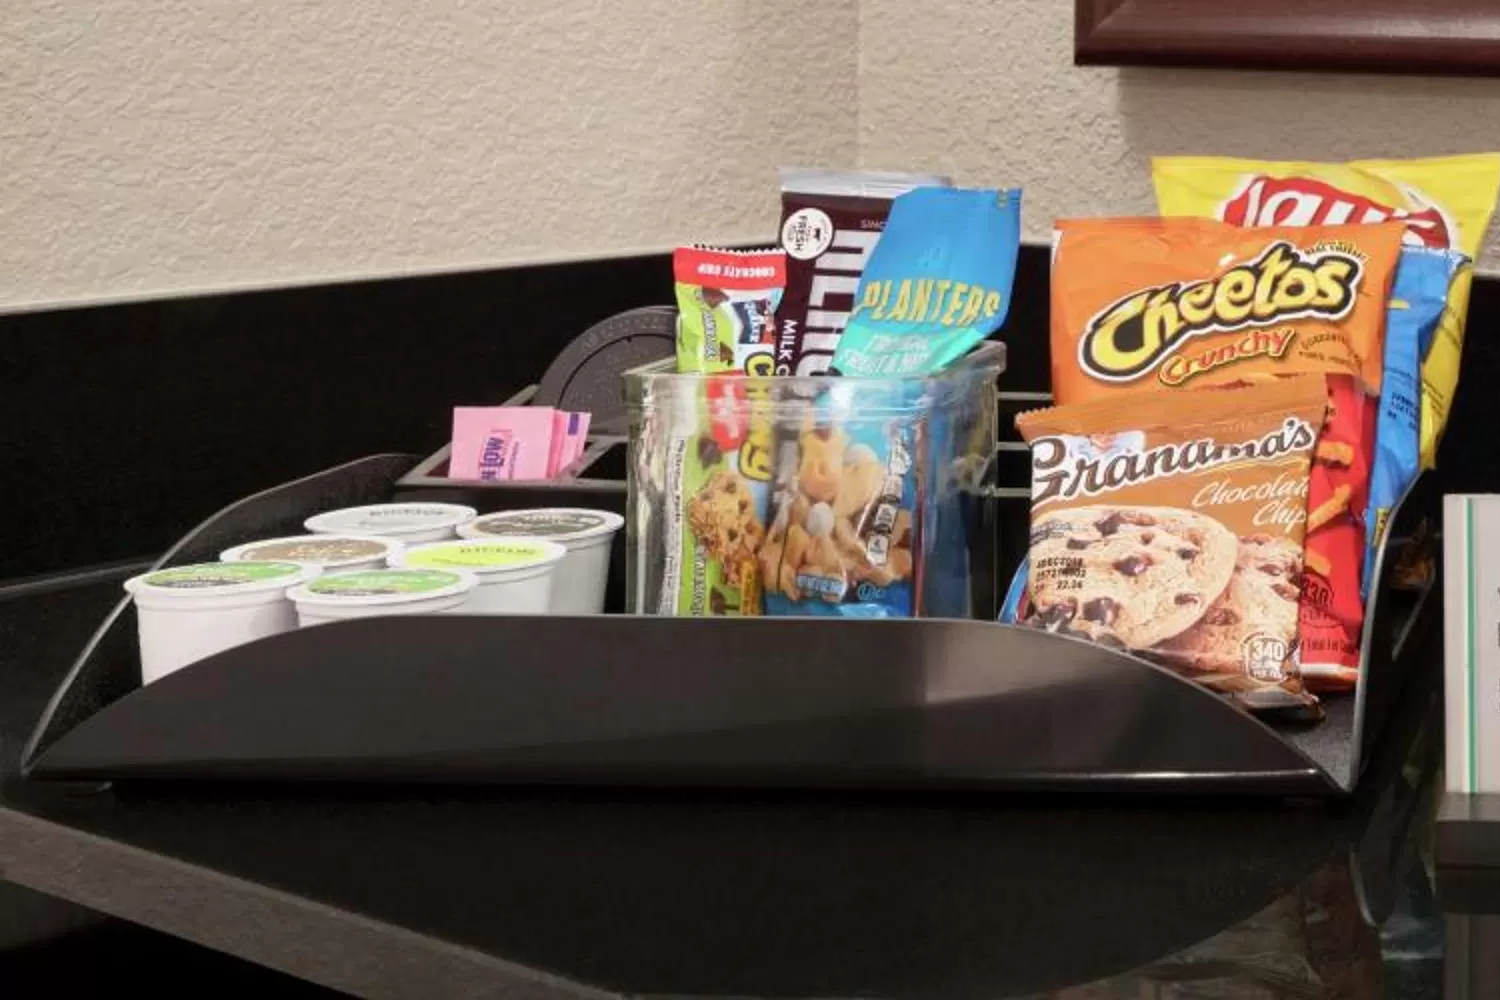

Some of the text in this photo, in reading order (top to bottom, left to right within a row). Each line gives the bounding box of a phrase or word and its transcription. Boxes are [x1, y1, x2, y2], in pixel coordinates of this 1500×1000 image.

[860, 219, 887, 231] SINC
[864, 279, 1001, 327] PLANTERS
[1084, 246, 1357, 376] Cheetos
[779, 319, 798, 361] MILK
[1158, 327, 1295, 385] Crunchy
[1252, 500, 1308, 533] Chip
[1250, 640, 1285, 661] 340
